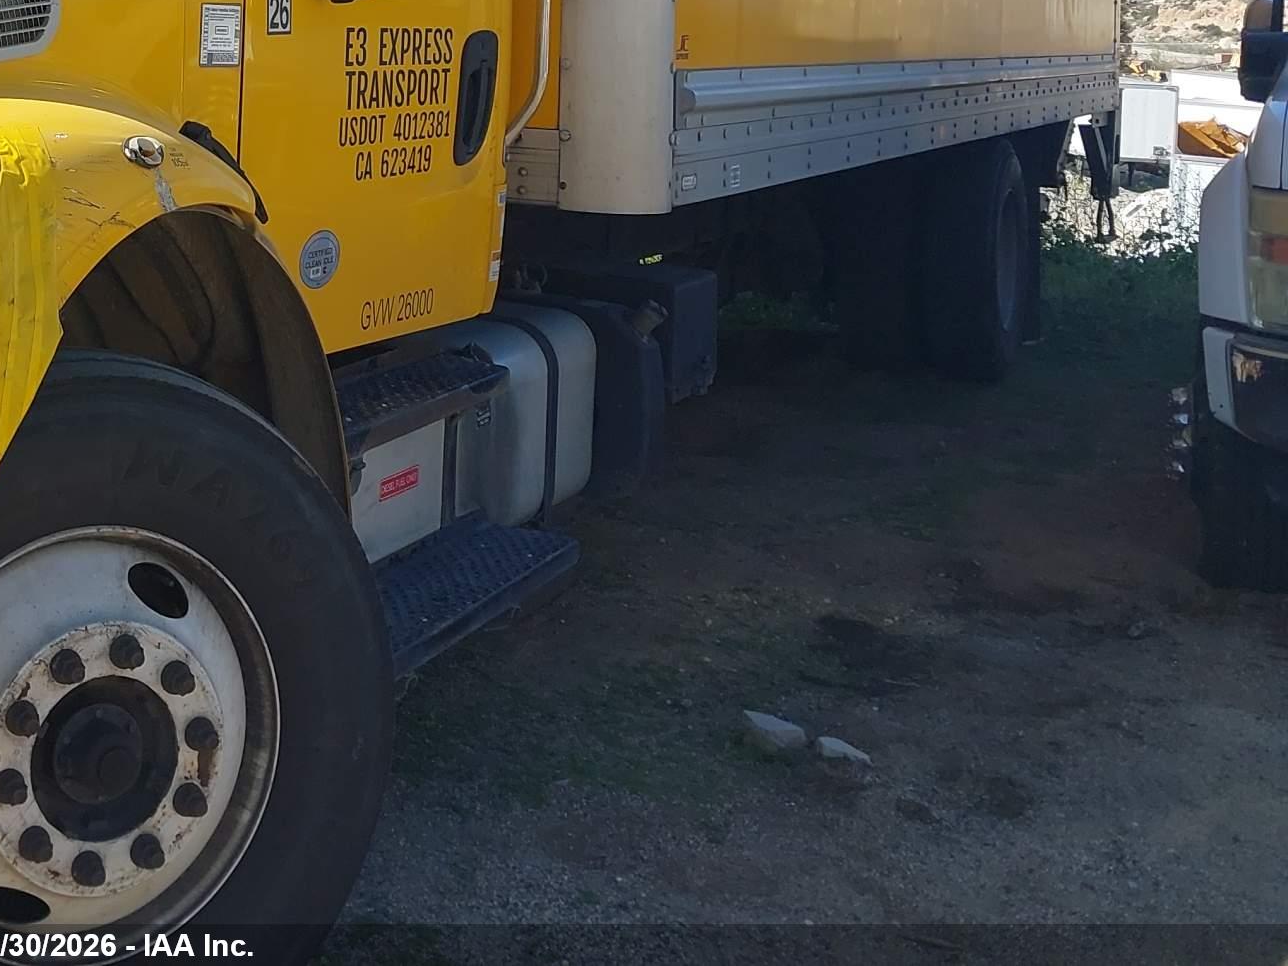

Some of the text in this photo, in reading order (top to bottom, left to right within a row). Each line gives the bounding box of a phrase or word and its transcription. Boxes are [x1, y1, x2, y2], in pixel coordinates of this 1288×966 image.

[345, 27, 453, 66] E3 EXPRESS
[345, 68, 451, 110] TRANSPORT
[339, 110, 450, 146] USDOT 4012381
[355, 144, 432, 181] CA 623419
[305, 260, 322, 269] CLEAN
[361, 288, 434, 330] GVW 26000
